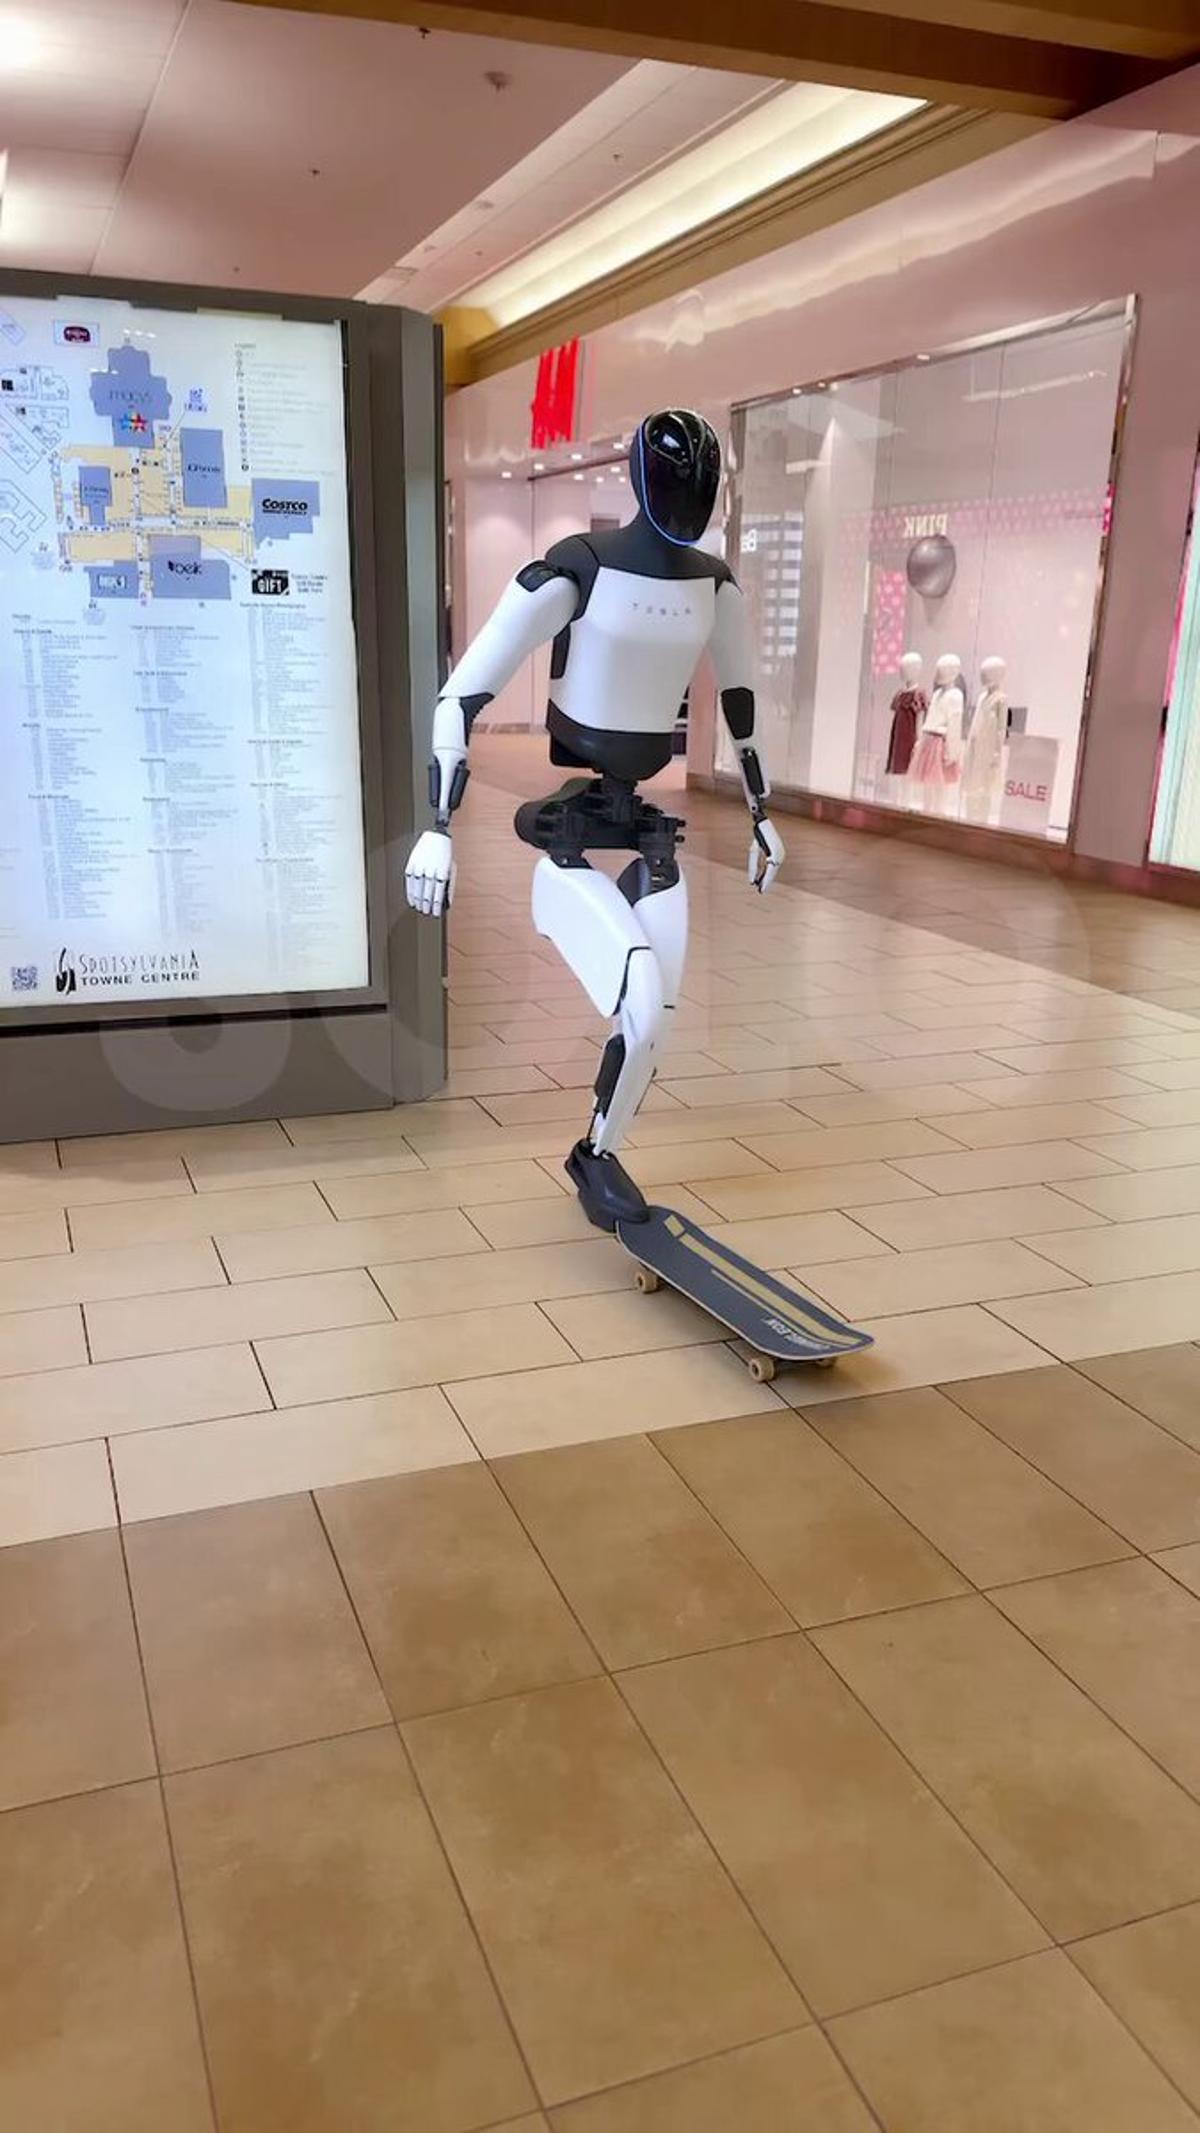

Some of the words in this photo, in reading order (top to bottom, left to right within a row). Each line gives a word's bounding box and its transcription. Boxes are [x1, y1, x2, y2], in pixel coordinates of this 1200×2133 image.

[631, 601, 692, 617] TESLA
[1004, 779, 1048, 802] SALE
[80, 974, 133, 986] TOWNE
[141, 971, 200, 984] CENTRE
